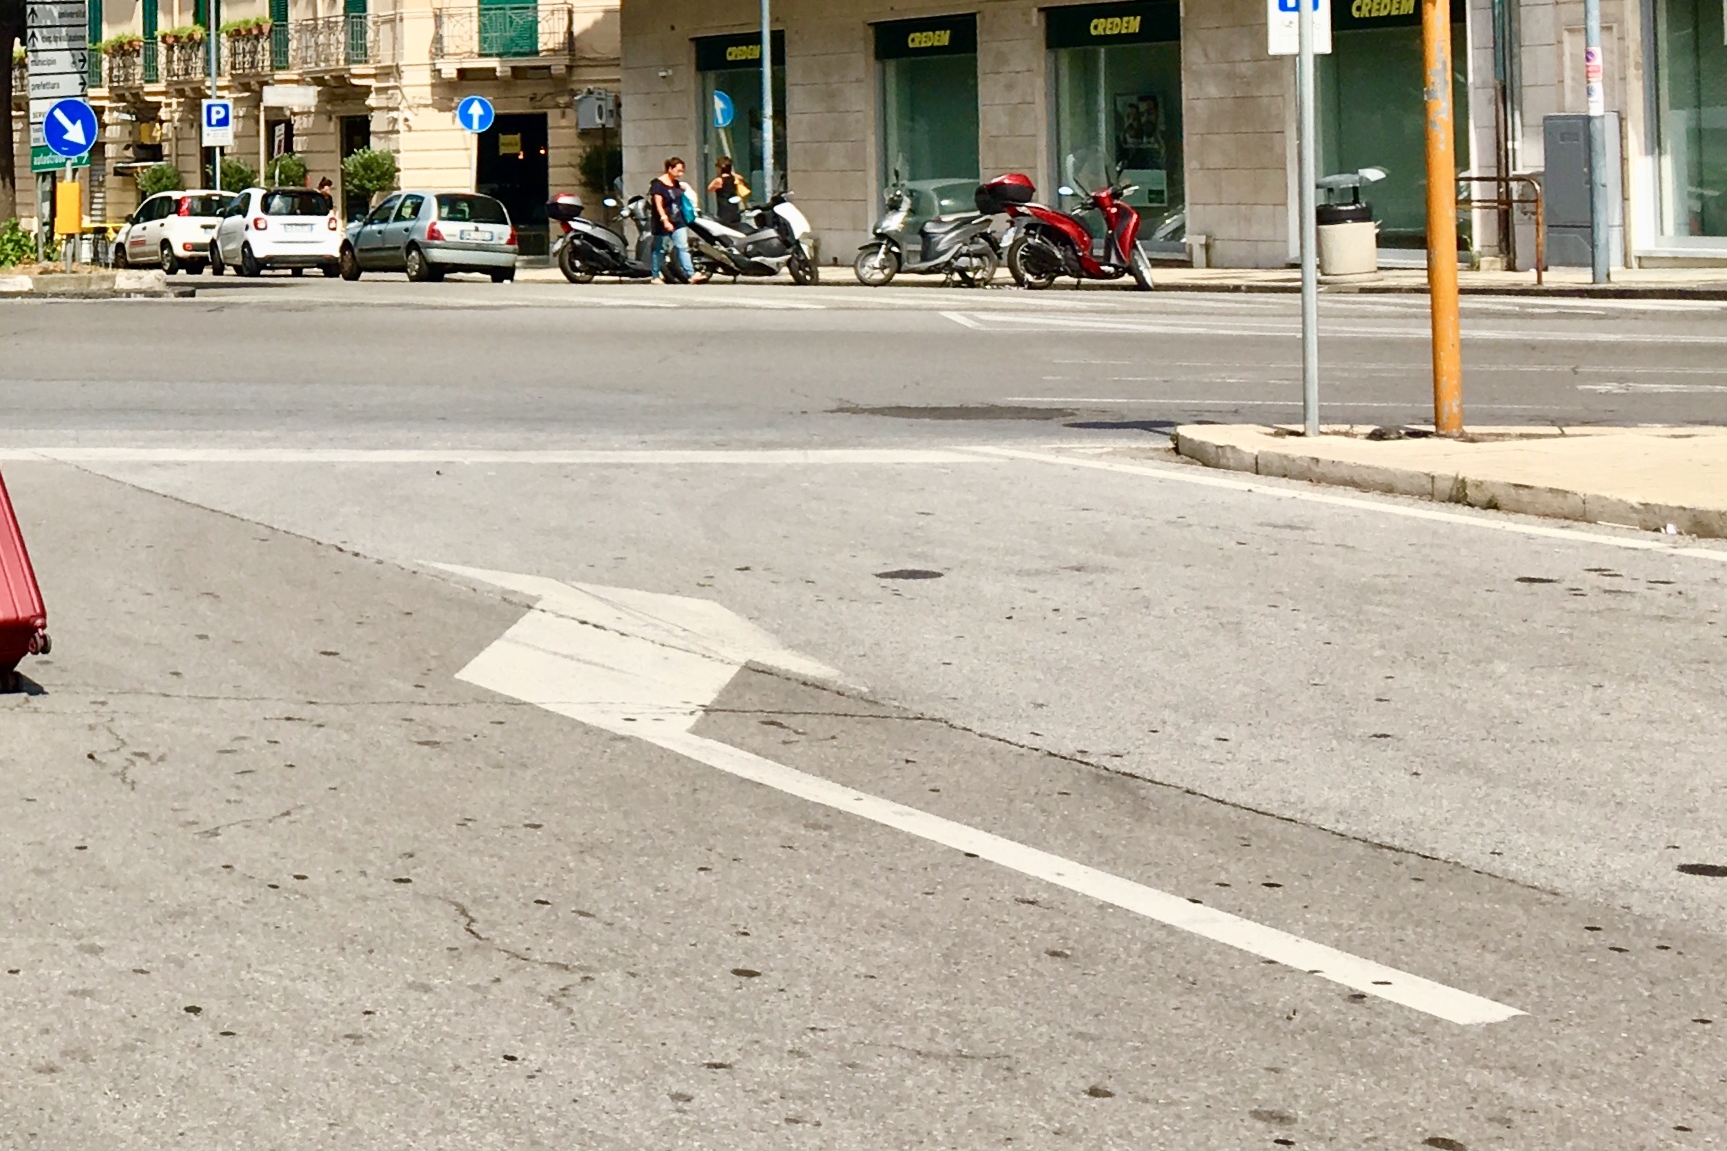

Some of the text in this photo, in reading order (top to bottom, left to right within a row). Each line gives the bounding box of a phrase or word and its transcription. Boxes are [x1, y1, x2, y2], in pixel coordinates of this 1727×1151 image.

[1089, 15, 1142, 36] CREDEM
[907, 29, 951, 49] CREDEM
[725, 44, 761, 61] CREDEM
[210, 106, 226, 125] P
